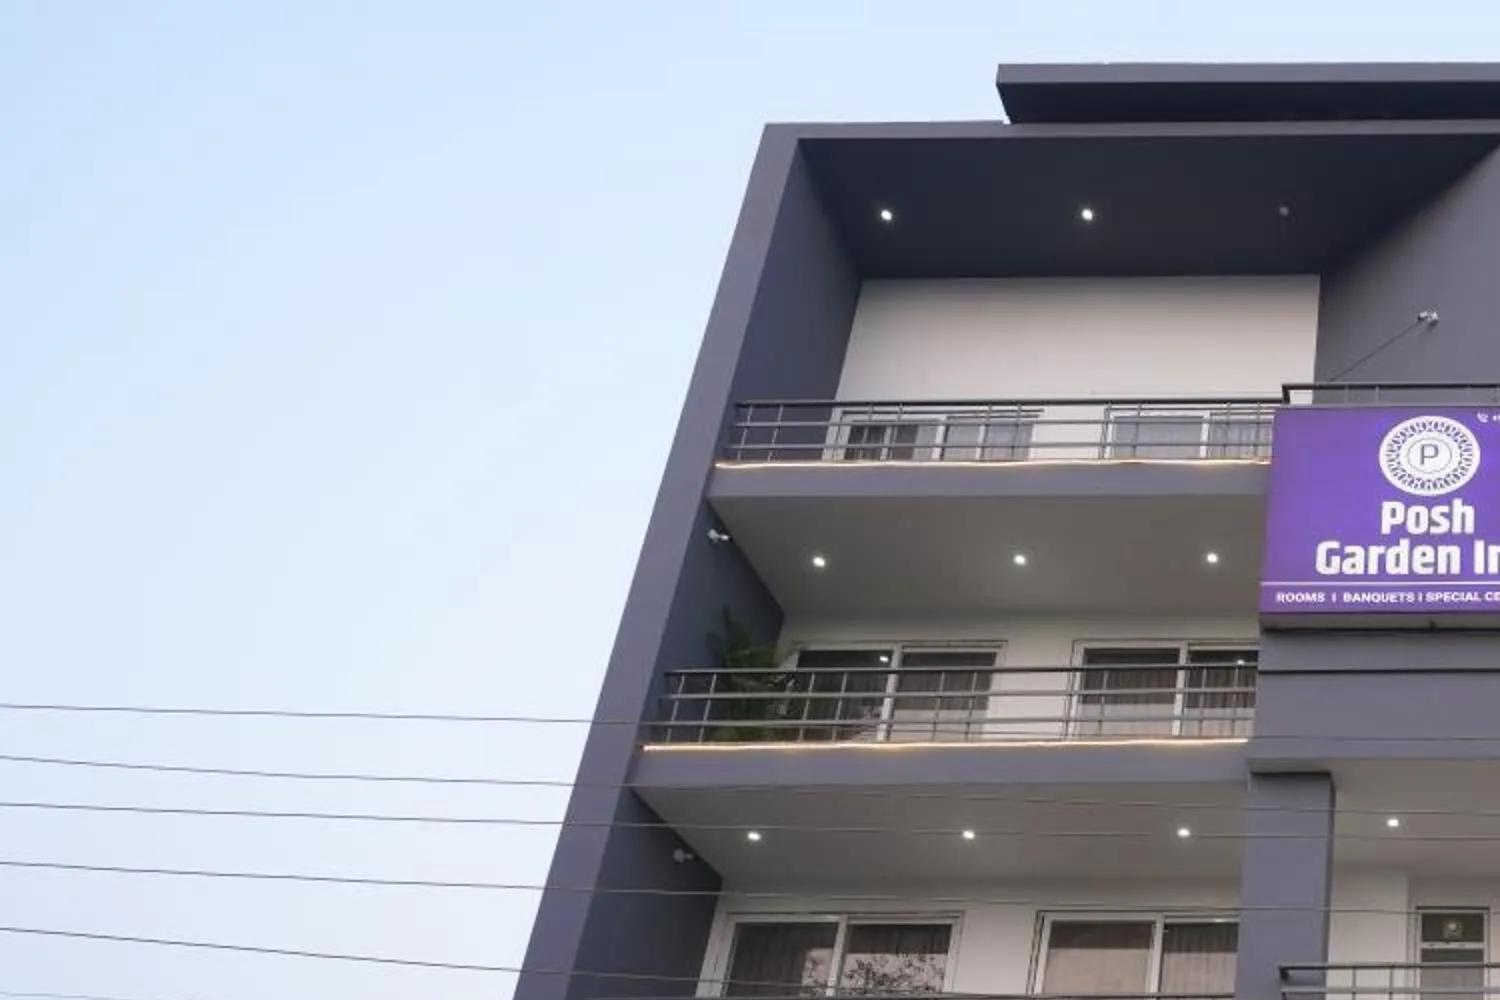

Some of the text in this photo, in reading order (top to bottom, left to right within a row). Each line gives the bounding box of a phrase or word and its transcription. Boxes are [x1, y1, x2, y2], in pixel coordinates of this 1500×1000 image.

[1420, 443, 1439, 465] P
[1380, 498, 1475, 535] Posh
[1315, 538, 1461, 576] Garden
[1275, 591, 1326, 603] ROOMS
[1342, 591, 1416, 604] BANQUETS
[1425, 591, 1482, 603] SPECIAL
